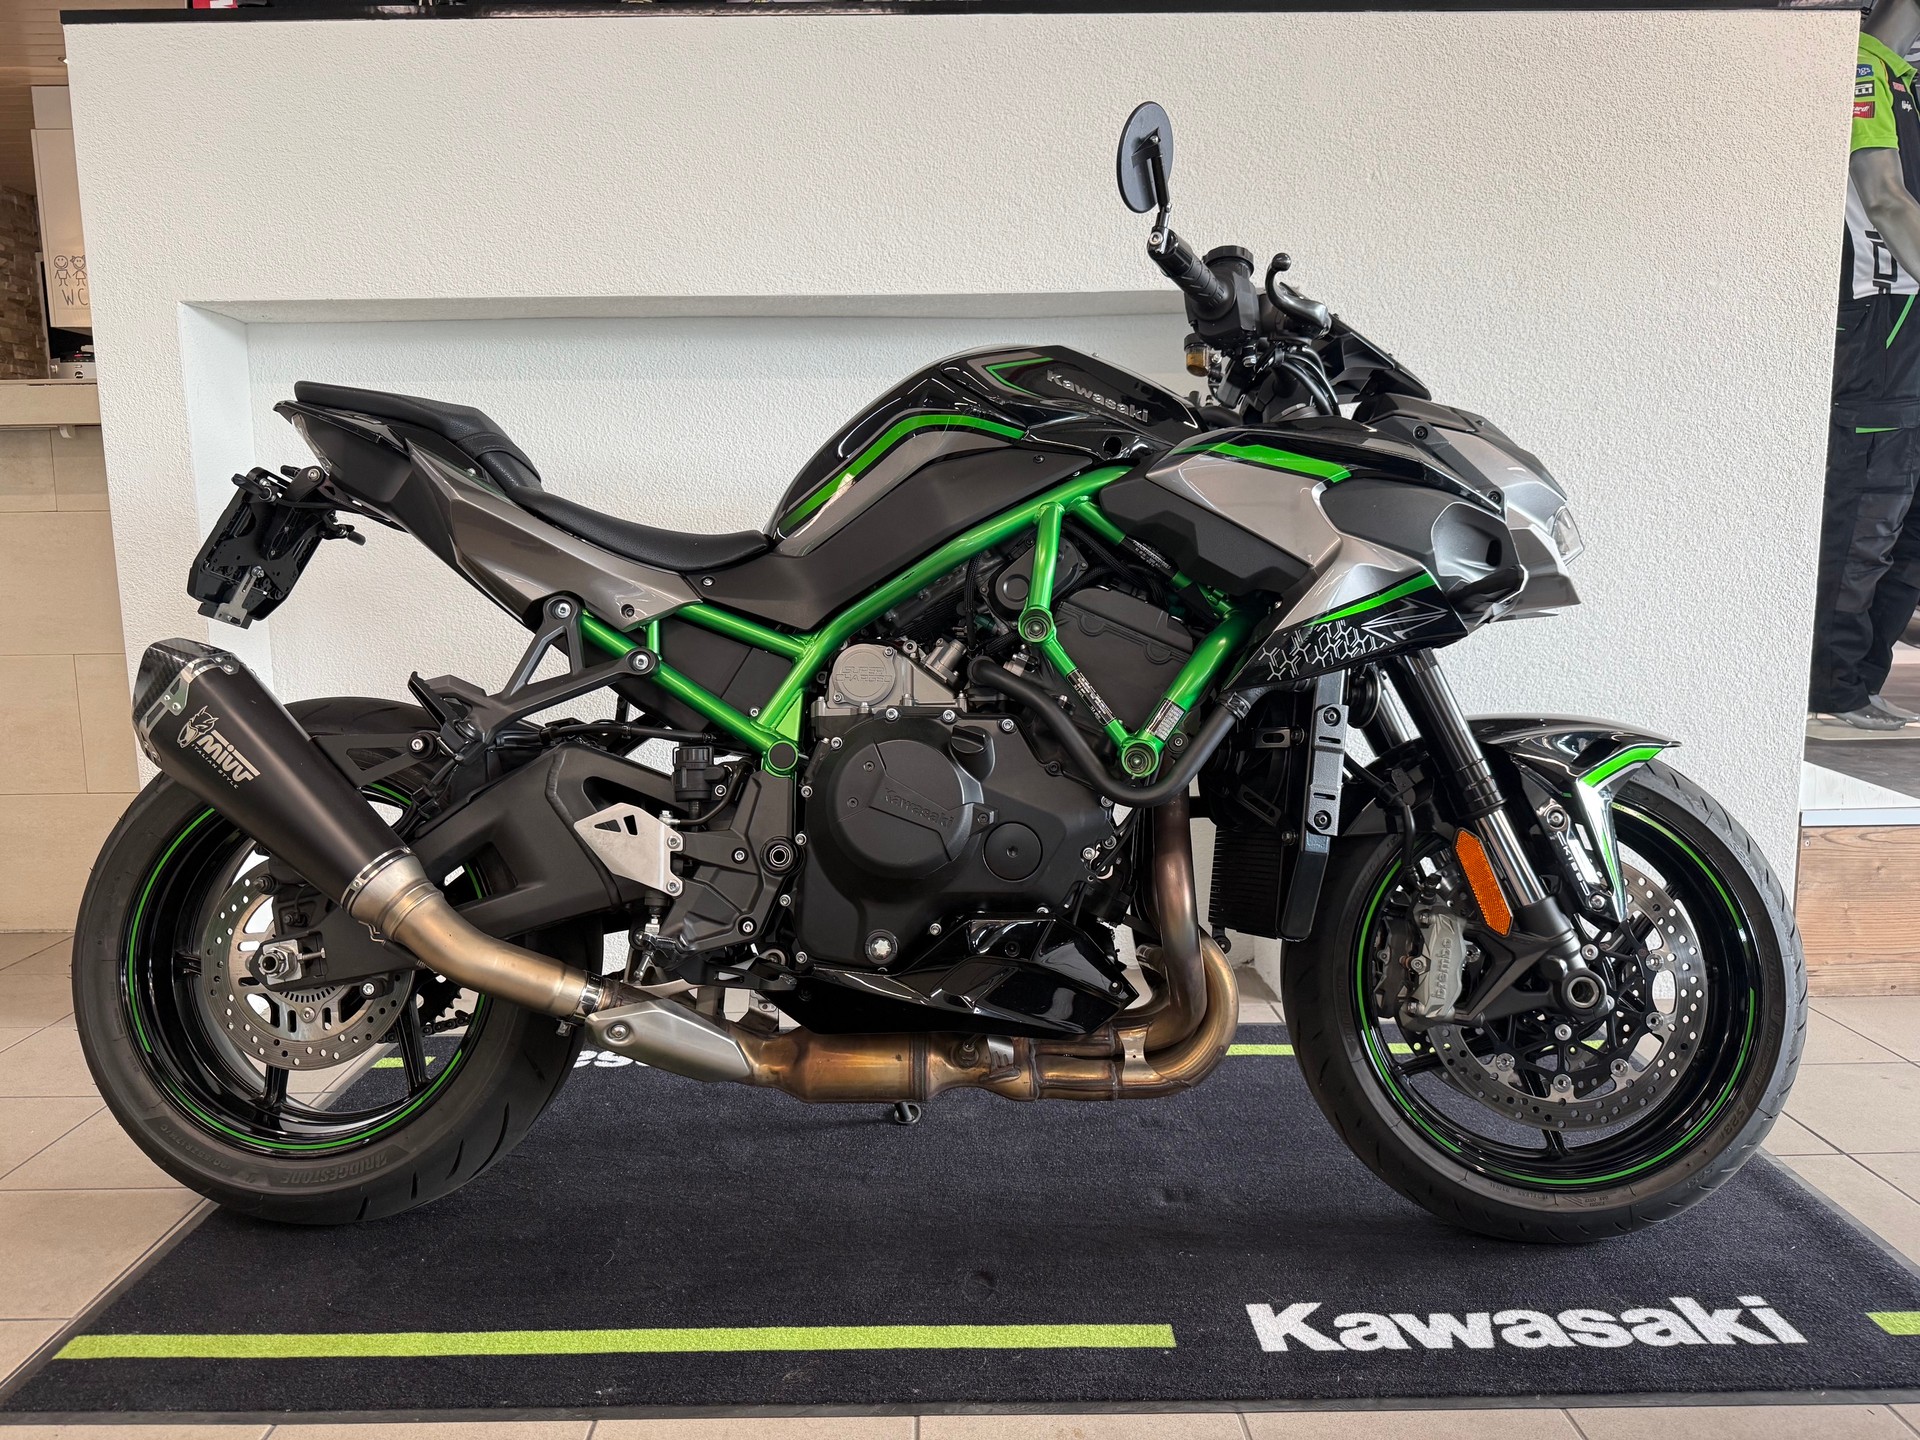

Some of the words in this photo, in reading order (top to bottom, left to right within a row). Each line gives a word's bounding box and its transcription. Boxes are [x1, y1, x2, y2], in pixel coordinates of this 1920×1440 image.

[62, 288, 88, 306] WC
[1046, 369, 1149, 423] Kawasaki
[835, 673, 893, 683] CHARGED
[842, 666, 885, 675] SUPER
[191, 743, 217, 769] ITALIAN
[217, 769, 239, 790] STYLE
[885, 787, 955, 829] Kawasaki
[1430, 938, 1453, 1000] brembo
[280, 1151, 388, 1184] BRIDGESTONE
[1245, 1296, 1808, 1352] Kawasaki
